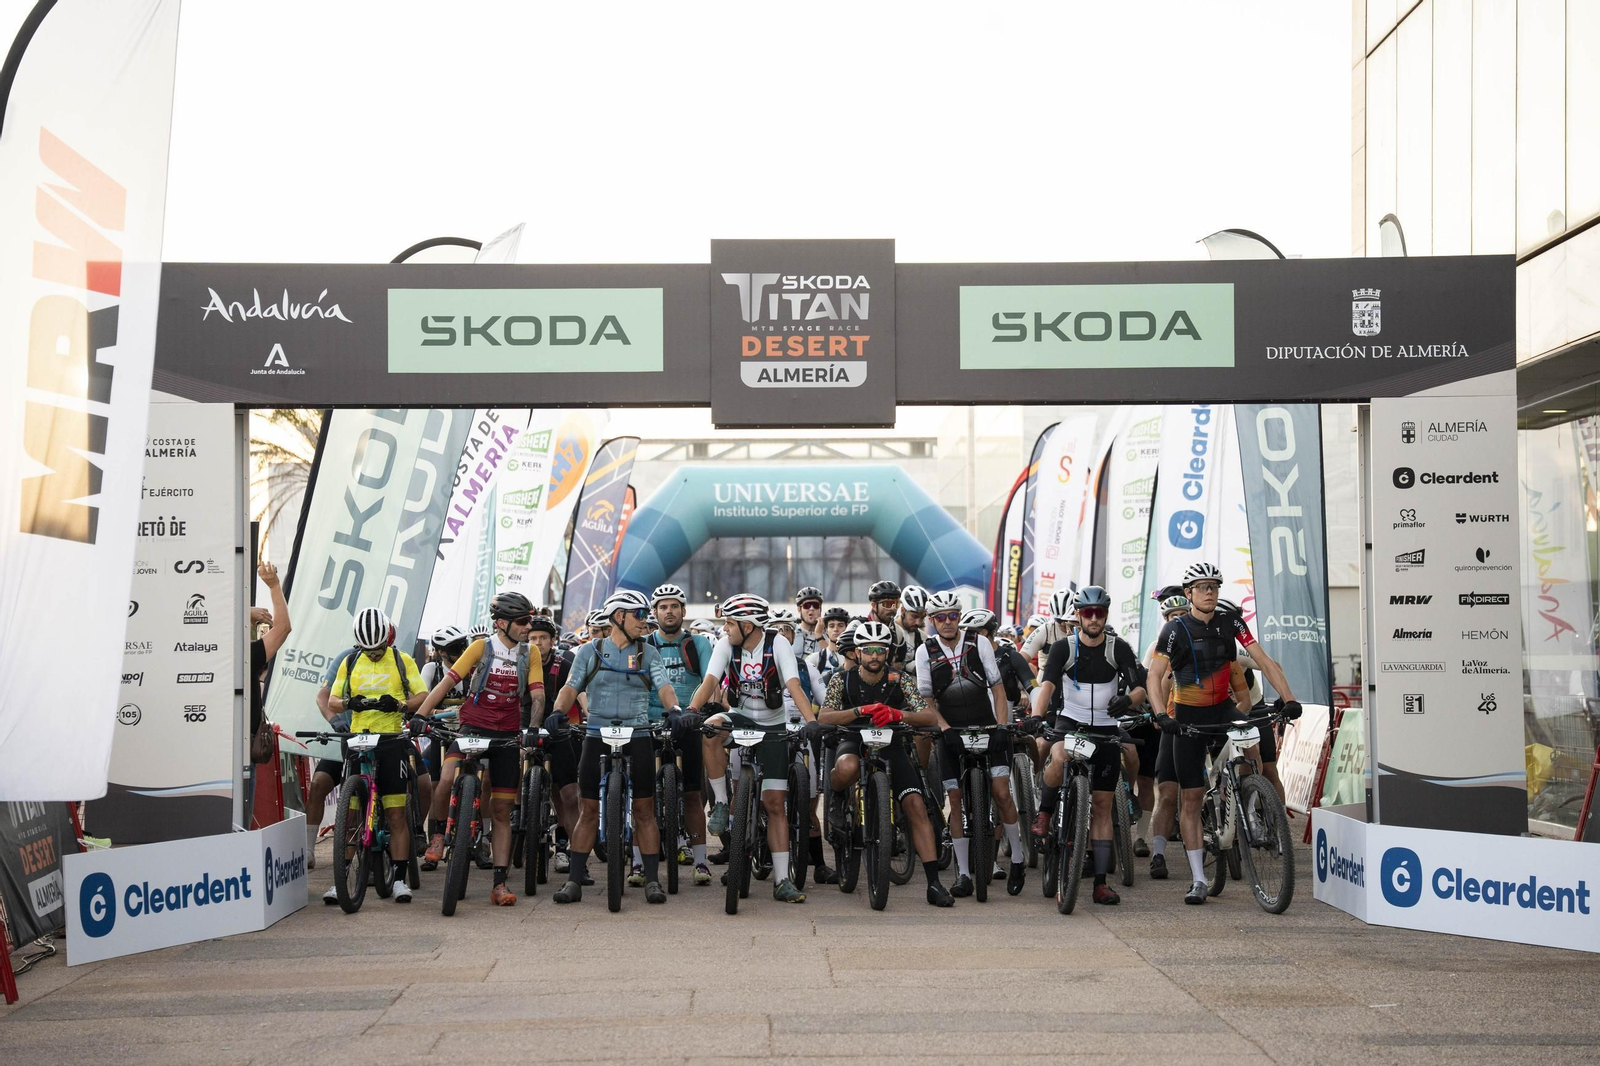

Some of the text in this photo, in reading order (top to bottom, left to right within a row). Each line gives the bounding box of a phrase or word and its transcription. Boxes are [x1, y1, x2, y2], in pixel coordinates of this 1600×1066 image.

[201, 287, 353, 323] Andalucía
[721, 273, 869, 323] TITAN
[19, 125, 127, 545] MRW
[421, 315, 631, 346] SKODA
[992, 310, 1202, 342] SKODA
[742, 335, 870, 356] DESERT
[1266, 342, 1469, 359] DIPUTACIÓN DE ALMERÍA
[757, 364, 849, 382] ALMERÍA
[1428, 419, 1488, 433] ALMERÍA
[1428, 434, 1459, 442] CIUDAD
[145, 446, 197, 457] ALMERÍA
[1183, 404, 1211, 501] Cleard
[447, 425, 519, 536] ALMERÍA
[1420, 471, 1499, 484] Cleardent
[149, 487, 194, 497] EJÉRCITO
[714, 482, 869, 503] UNIVERSAE
[714, 504, 869, 519] Instituto Superior de FP
[1393, 521, 1426, 529] primaflor
[1389, 595, 1432, 605] MRW
[1392, 628, 1432, 639] Almería
[281, 667, 296, 677] We
[1405, 695, 1423, 712] RAC 1
[184, 713, 206, 722] 100
[19, 836, 57, 875] DESERT
[274, 848, 305, 888] Cleardent
[1329, 846, 1365, 888] Cleardent
[124, 867, 251, 917] Cleardent
[1431, 867, 1591, 914] Cleardent
